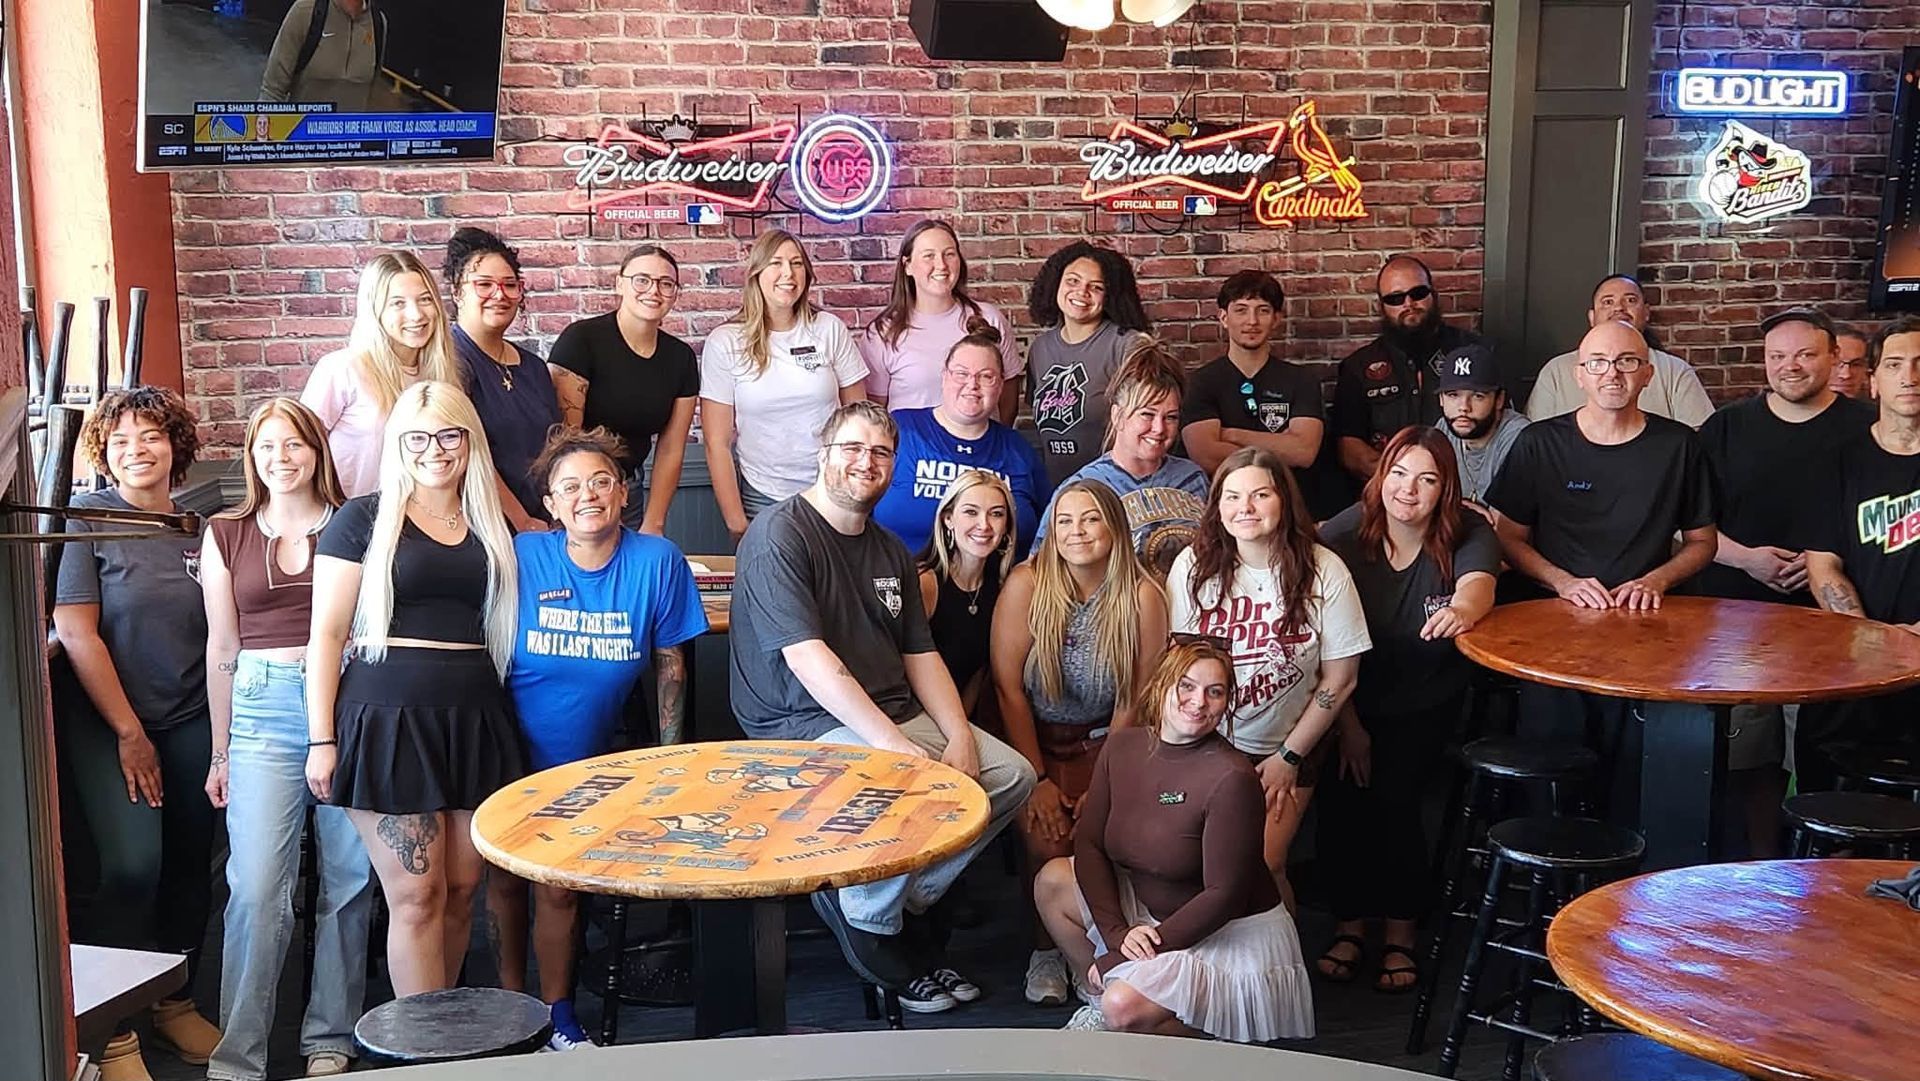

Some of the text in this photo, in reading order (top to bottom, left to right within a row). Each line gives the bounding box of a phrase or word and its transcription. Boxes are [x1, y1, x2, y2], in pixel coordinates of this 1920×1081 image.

[1686, 76, 1841, 107] BUD LIGHT
[197, 103, 332, 112] ESPN'S SHAMS CHARANIA REPORTS
[163, 123, 184, 135] SC
[307, 121, 343, 134] WARRIORS
[345, 121, 360, 134] HIRE
[361, 120, 382, 133] FRANK
[383, 120, 404, 133] VOGEL
[405, 120, 414, 132] AS
[438, 119, 455, 132] HEAD
[456, 119, 477, 131] COACH
[158, 146, 187, 155] ESPN
[563, 143, 789, 185] Budweiser
[1080, 142, 1275, 181] Budweiser
[1111, 200, 1179, 210] OFFICIAL BEER
[1255, 182, 1368, 227] Cardinals
[1728, 175, 1807, 212] Bandits
[604, 209, 680, 220] OFFICIAL BEER
[1453, 357, 1472, 375] NY
[1050, 441, 1076, 454] 1959
[539, 606, 631, 634] WHERE THE HELL
[1230, 595, 1271, 624] Dr
[1199, 607, 1312, 650] Peppe
[527, 630, 550, 655] WAS
[552, 633, 558, 655] I
[559, 634, 590, 658] LAST
[774, 837, 904, 863] FIGHTIN IRISH
